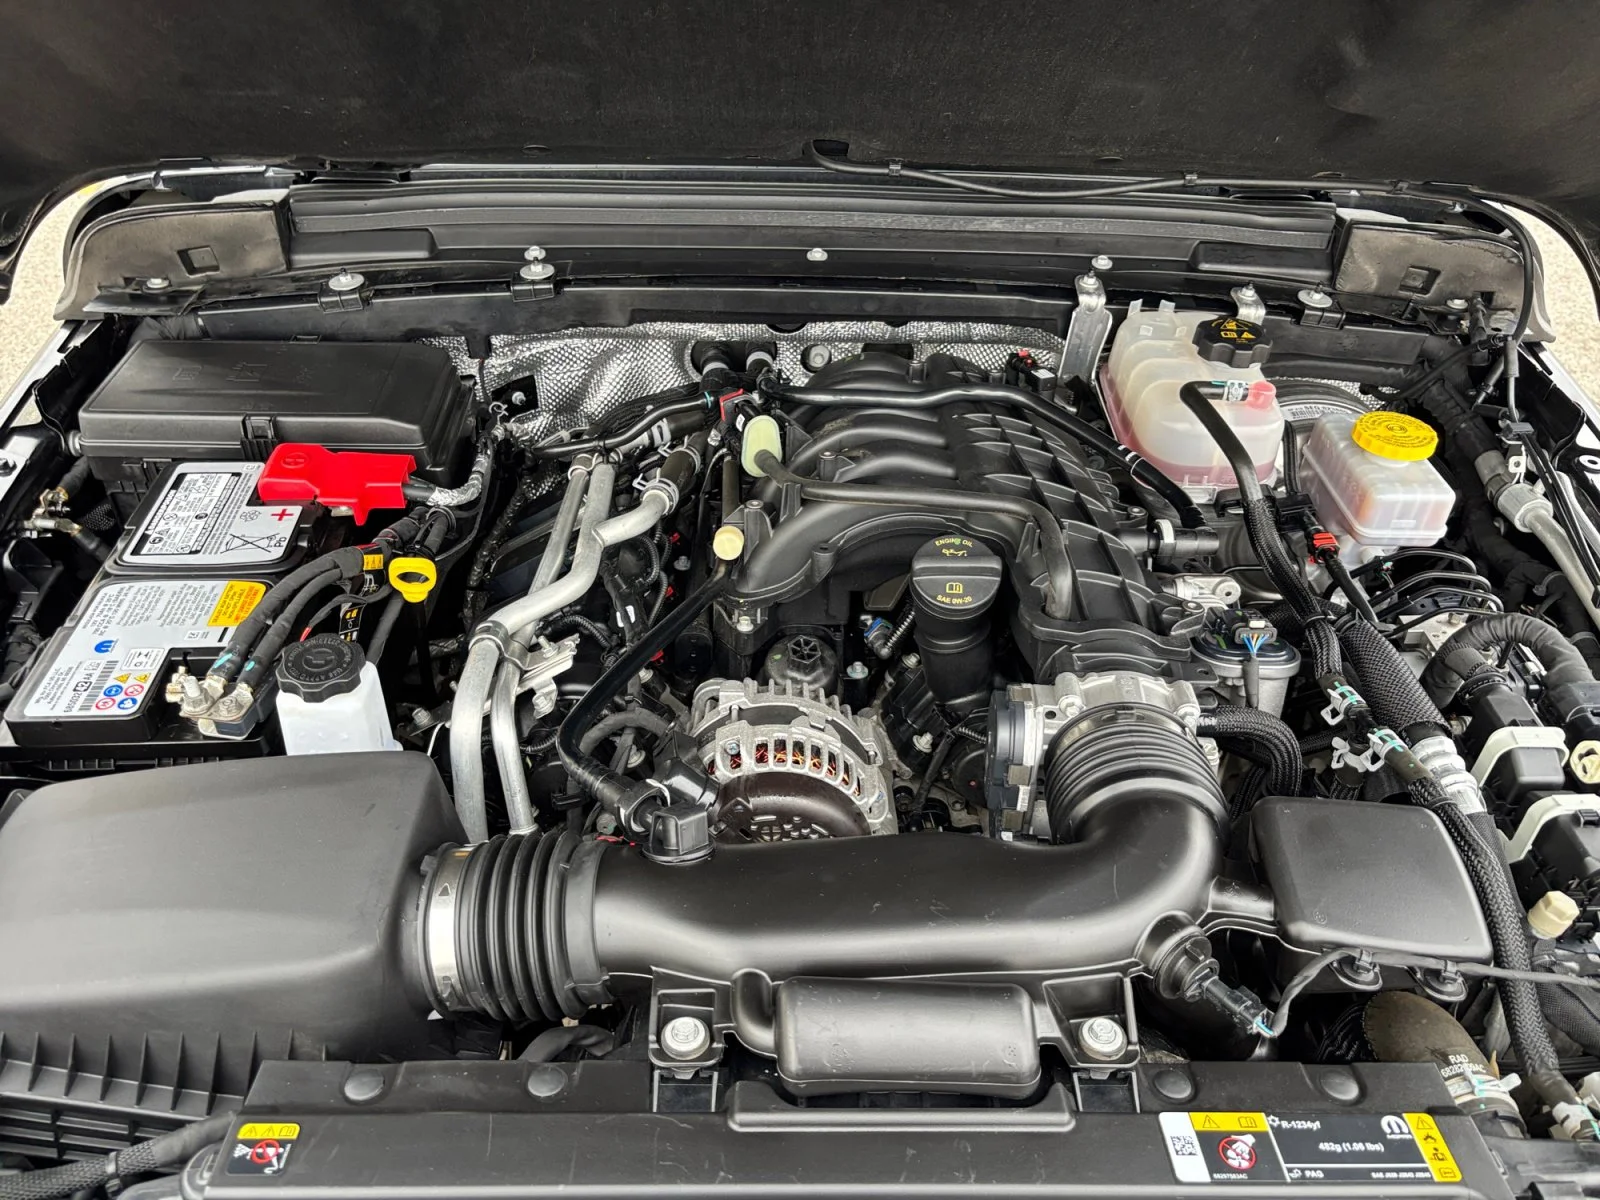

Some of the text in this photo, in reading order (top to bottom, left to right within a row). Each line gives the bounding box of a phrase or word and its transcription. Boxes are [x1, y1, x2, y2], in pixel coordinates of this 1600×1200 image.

[935, 538, 973, 547] ENGINE OIL
[937, 595, 972, 604] SAE 0W-20
[1448, 1054, 1469, 1064] RAD
[1366, 1142, 1385, 1152] lbs)
